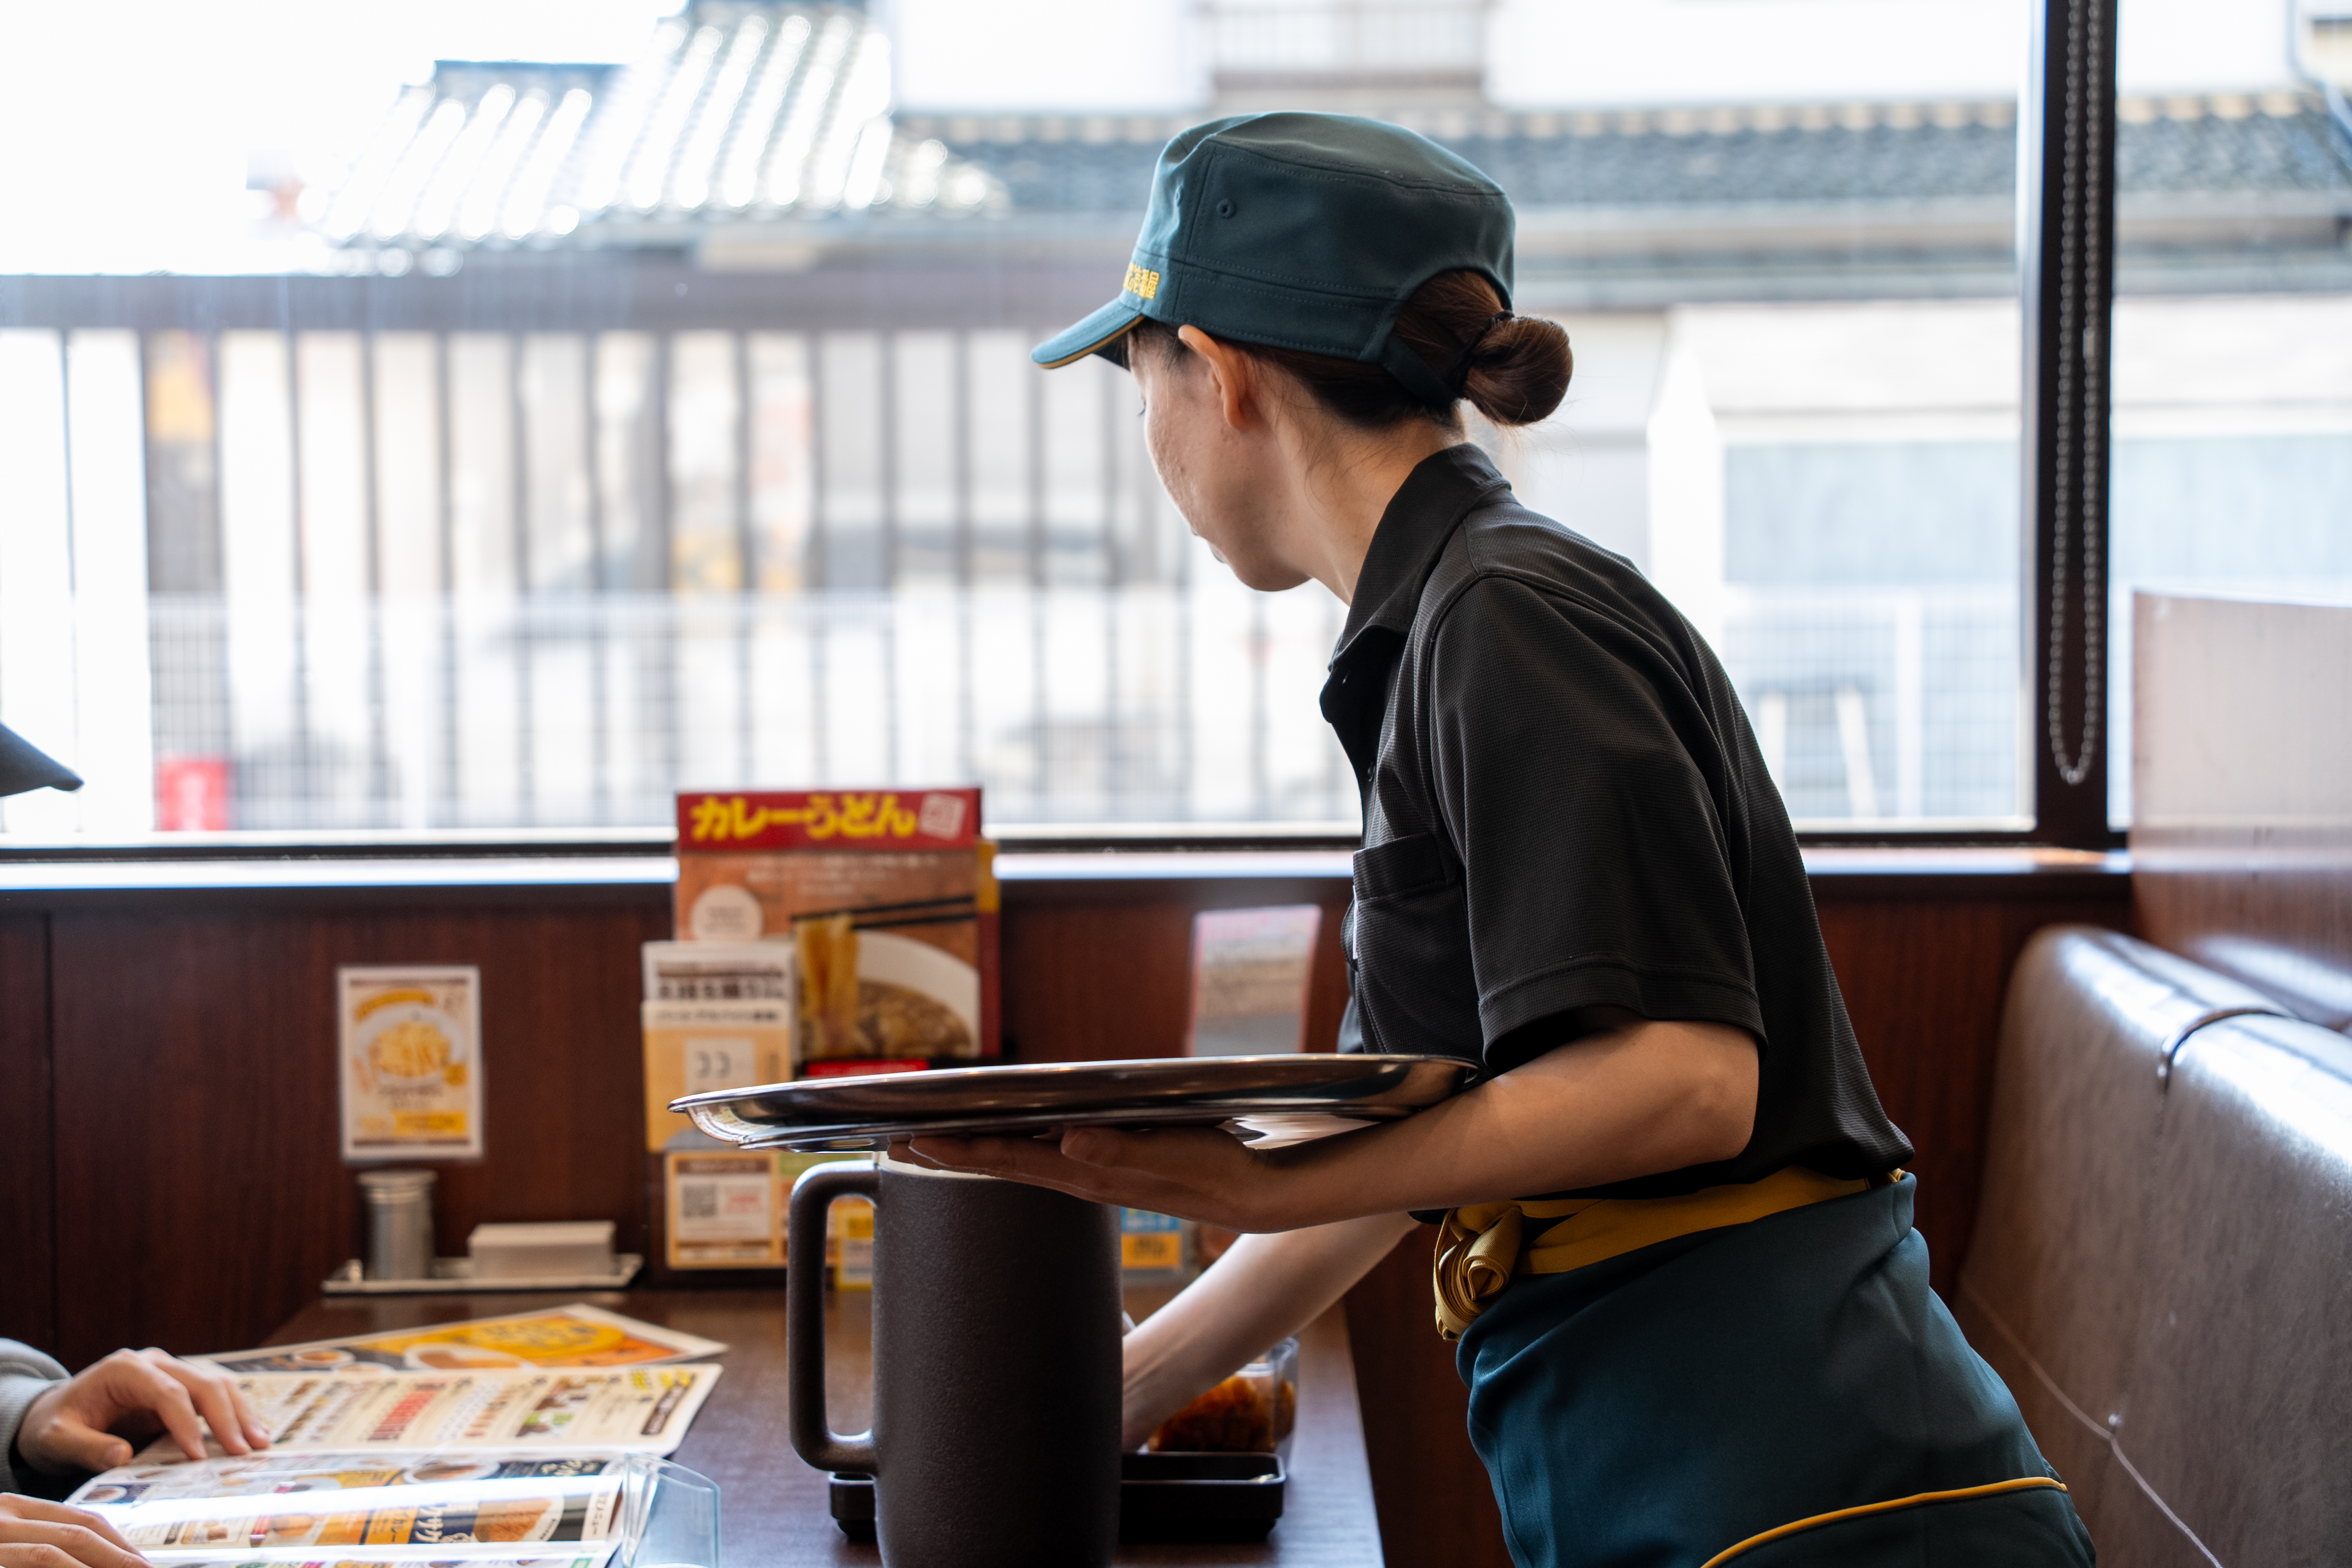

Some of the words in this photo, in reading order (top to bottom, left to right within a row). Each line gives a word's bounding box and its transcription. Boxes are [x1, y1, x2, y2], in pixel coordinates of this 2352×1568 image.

[691, 794, 916, 840] カレーうどん
